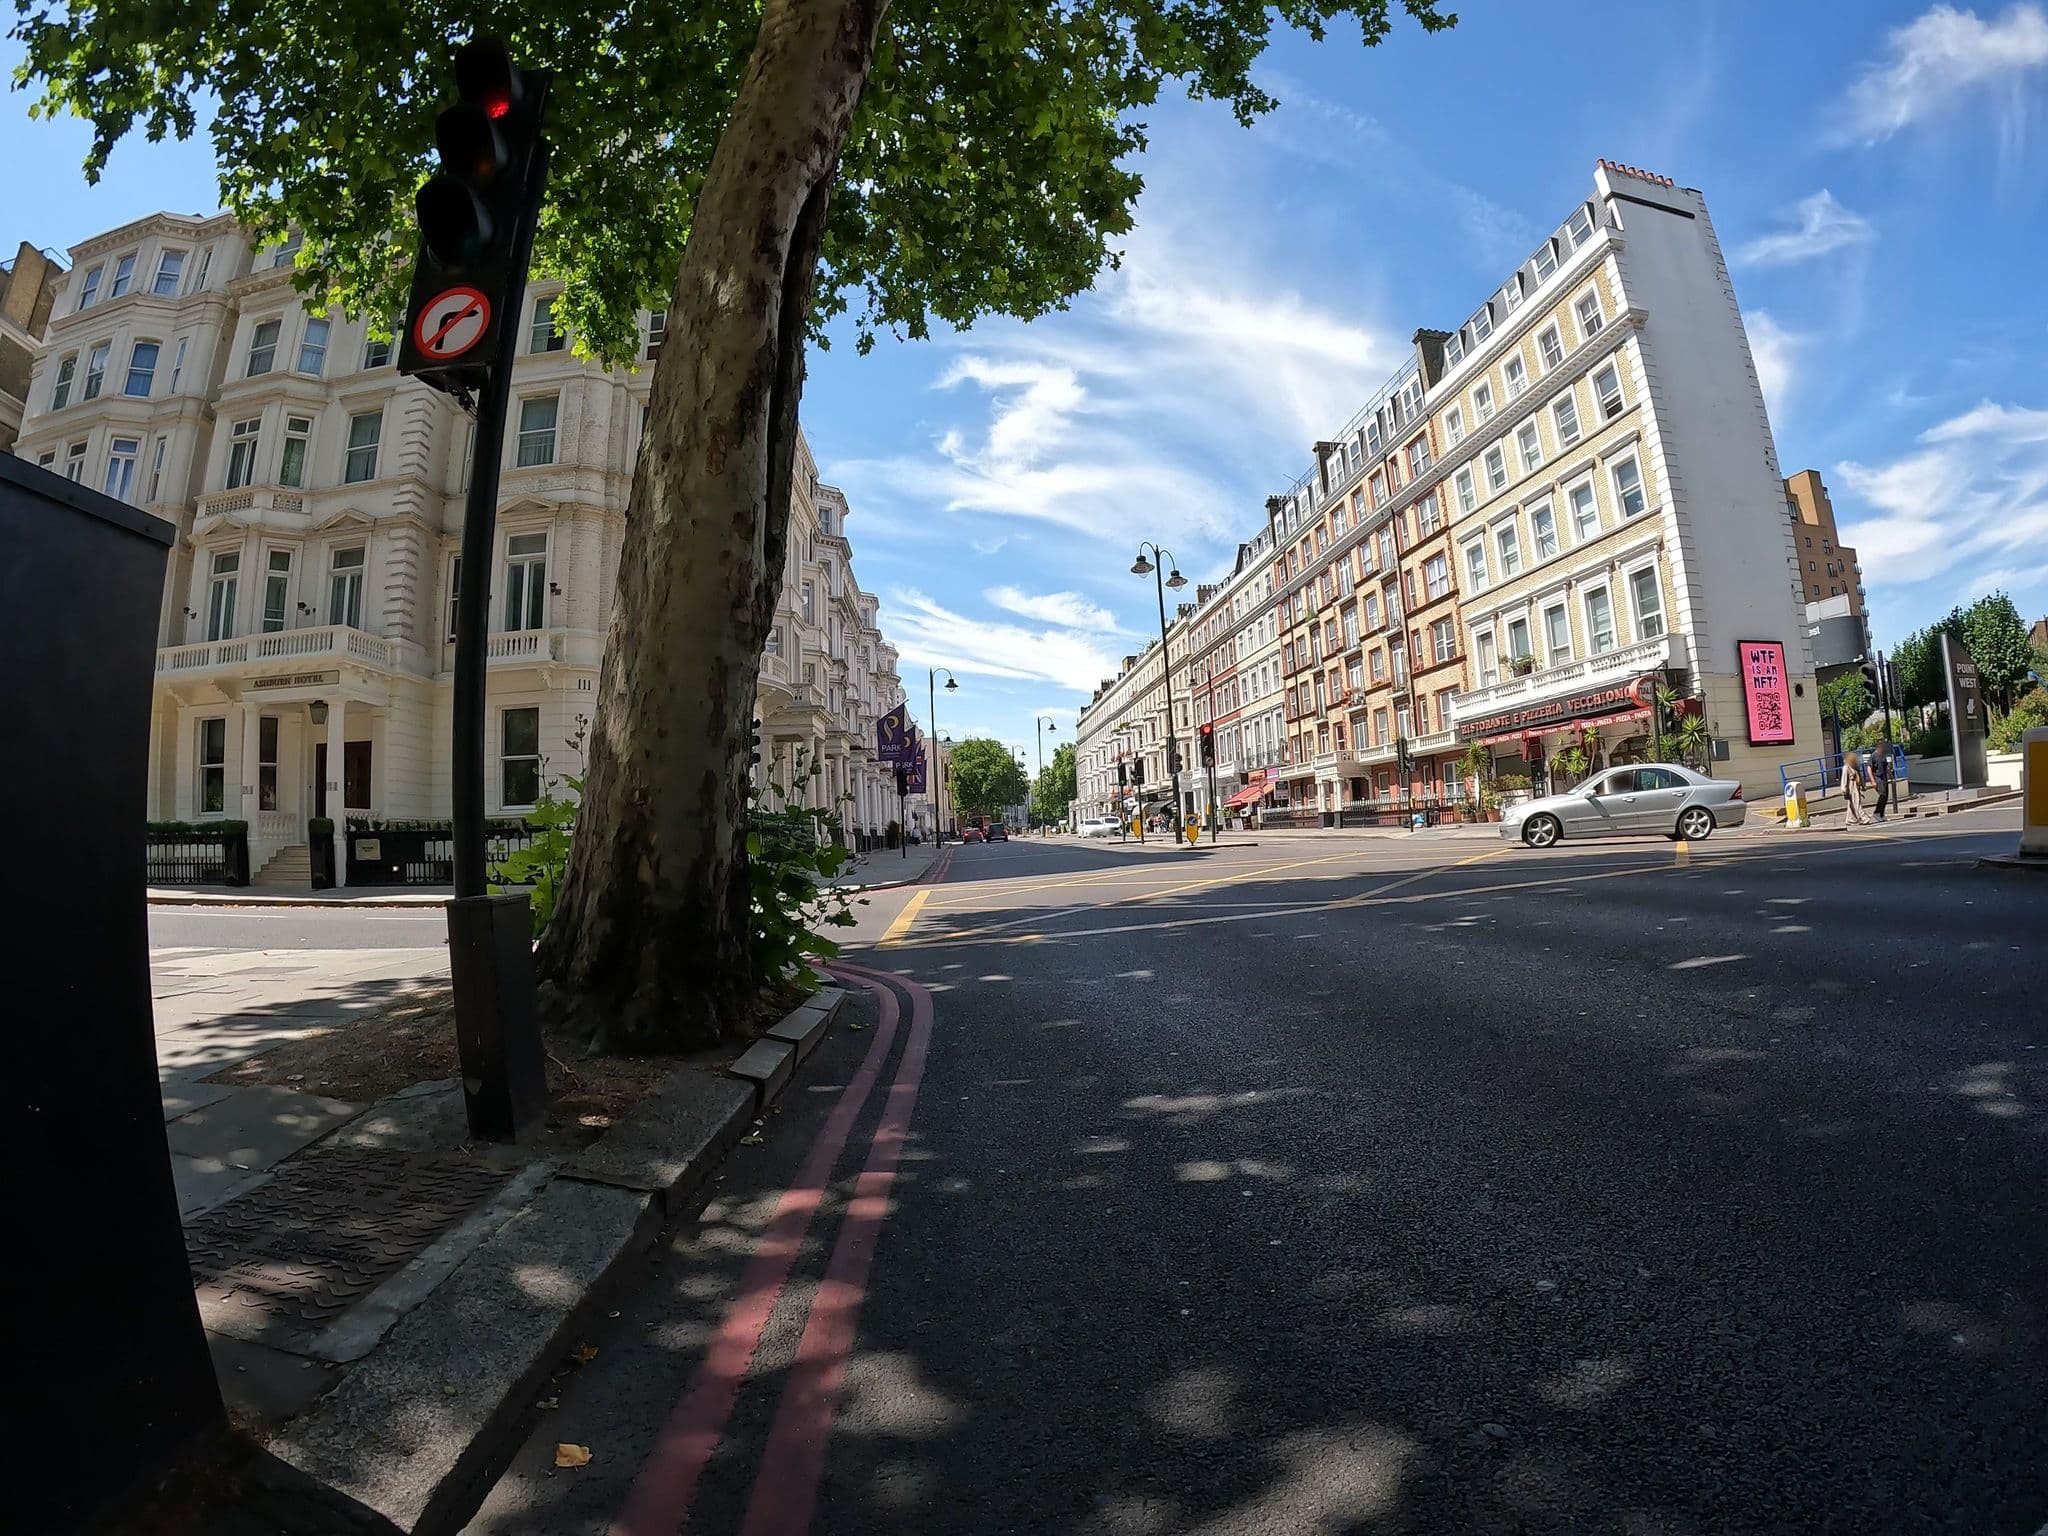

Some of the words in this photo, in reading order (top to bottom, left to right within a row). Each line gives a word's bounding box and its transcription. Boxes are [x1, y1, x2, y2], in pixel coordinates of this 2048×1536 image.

[1750, 650, 1775, 663] WTF
[1752, 665, 1761, 674] IS
[1956, 663, 1975, 673] POINT
[254, 677, 291, 688] ASHBURN
[294, 674, 324, 684] HOTEL
[1959, 678, 1977, 688] WEST
[1461, 715, 1511, 735] RISTORANTE
[1513, 712, 1520, 723] E
[1521, 702, 1563, 721] PIZZERIA
[1634, 709, 1652, 719] PASTA
[881, 744, 902, 752] PARK
